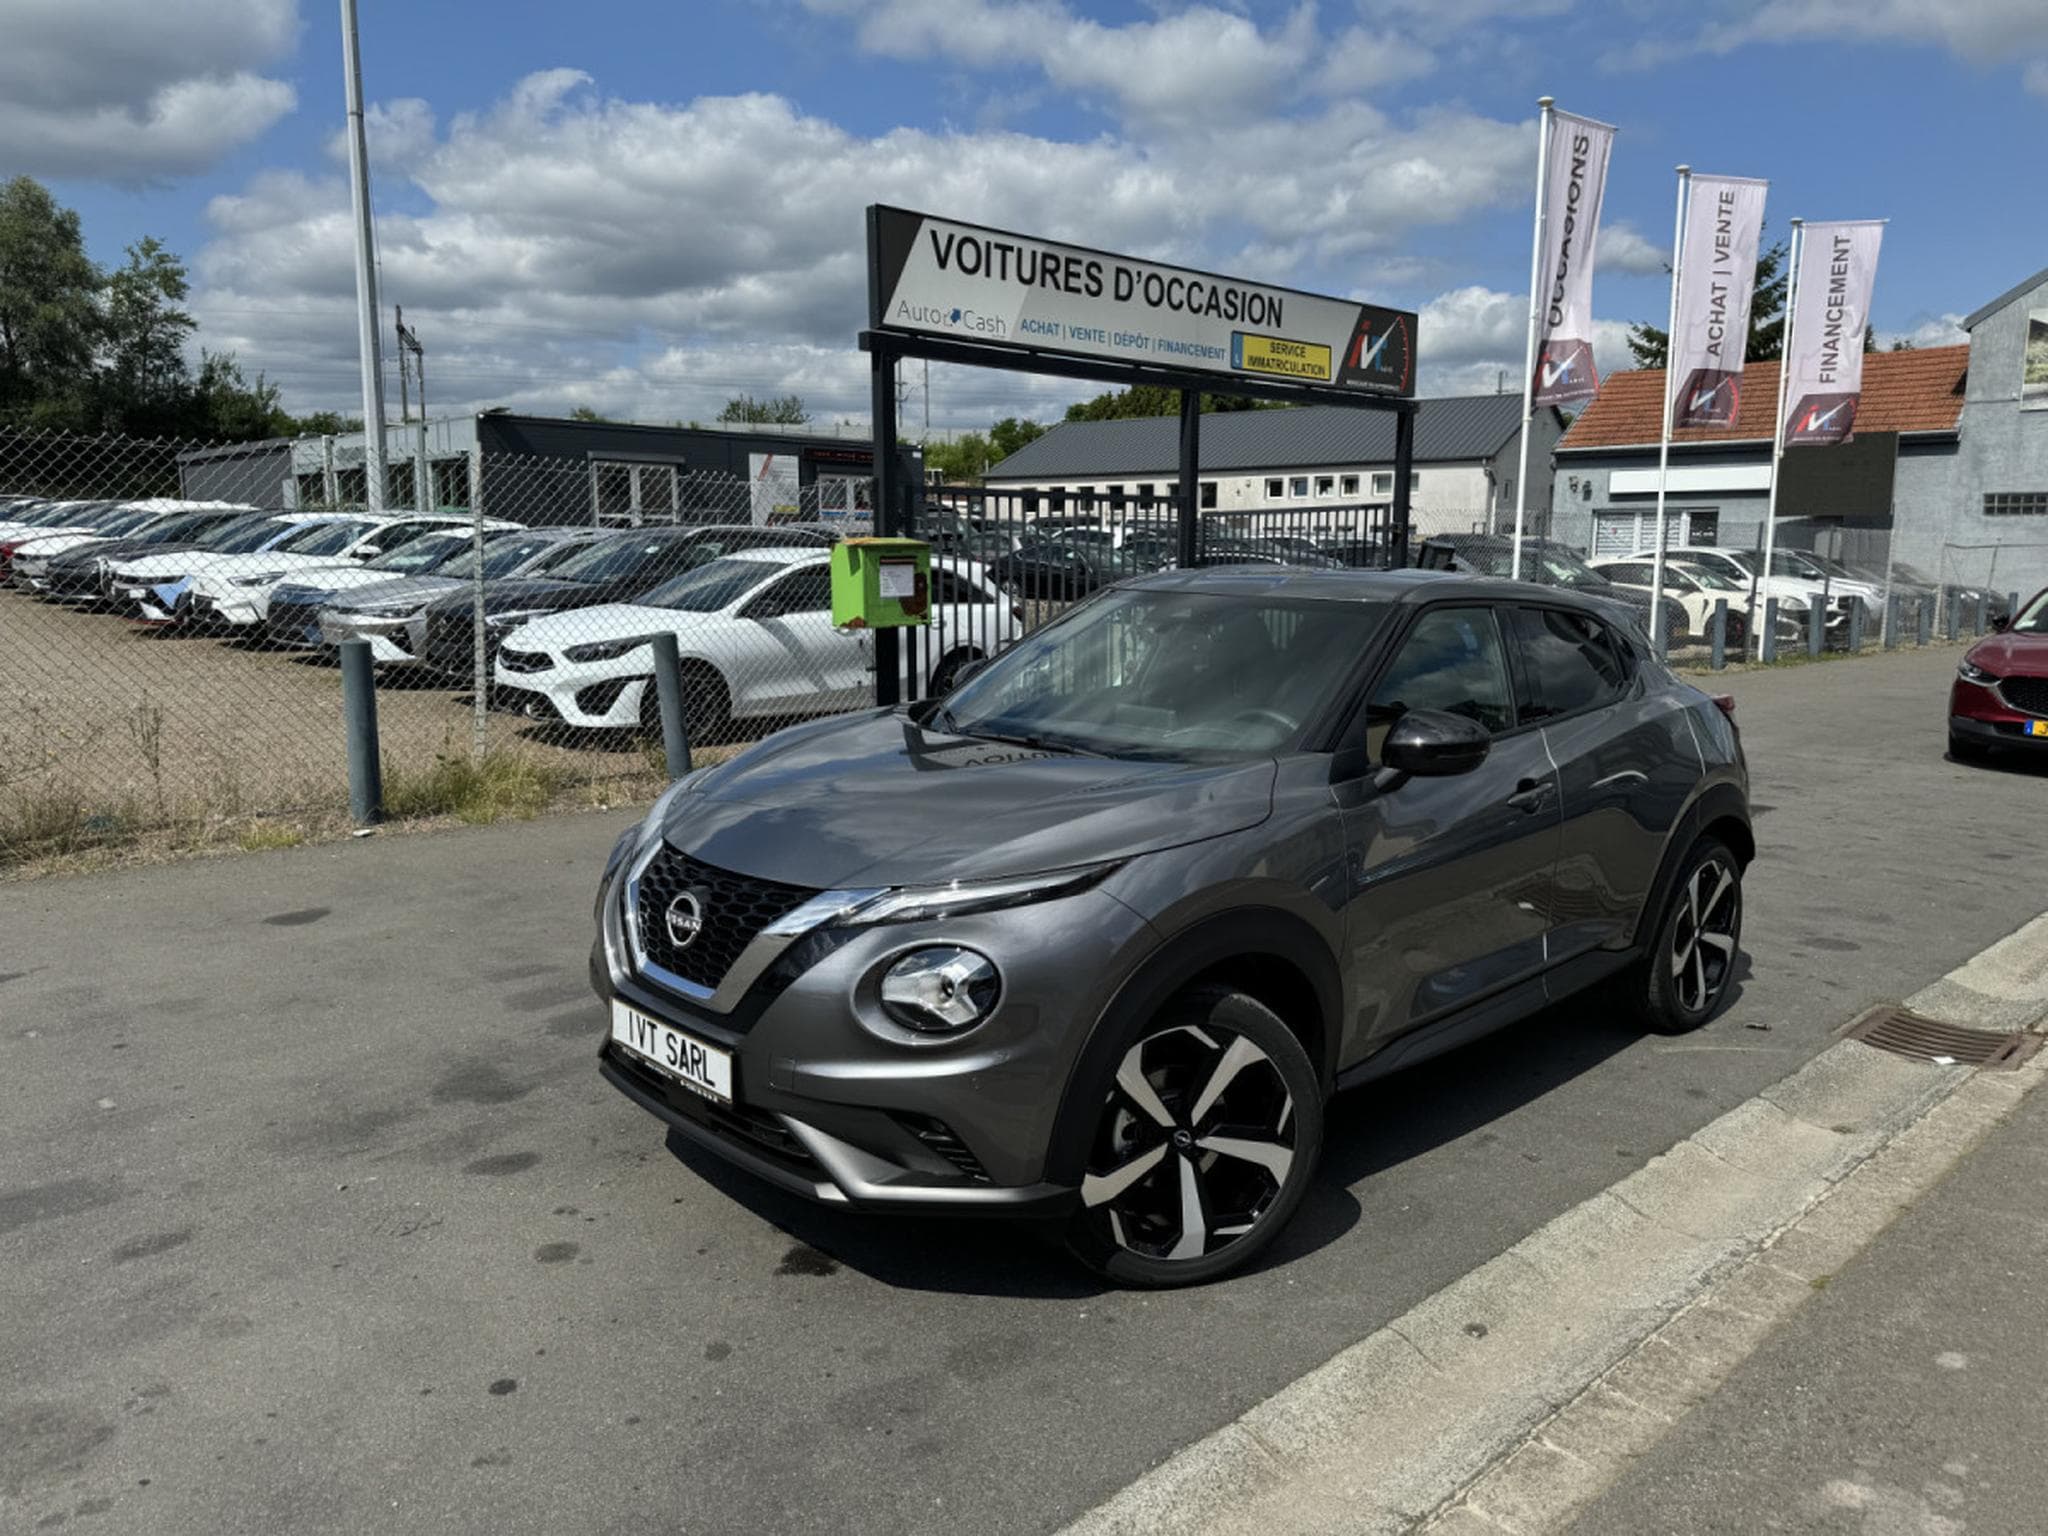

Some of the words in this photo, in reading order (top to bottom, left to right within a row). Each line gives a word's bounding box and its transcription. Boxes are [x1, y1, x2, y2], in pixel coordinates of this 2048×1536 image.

[930, 229, 1103, 298] VOITURES
[1549, 136, 1589, 328] OCCASIONS
[1714, 191, 1735, 267] VENTE
[963, 310, 1006, 334] Cash
[1021, 318, 1060, 336] ACHAT
[1069, 326, 1105, 343] VENTE
[1114, 331, 1150, 349] DÉPÔT
[1158, 339, 1226, 361] FINANCEMENT
[1706, 282, 1728, 356] ACHAT
[1819, 235, 1851, 384] FINANCEMENT
[1247, 355, 1325, 375] IMMATRICULATION
[1270, 341, 1306, 358] SERVICE
[629, 1010, 657, 1054] IVT
[666, 1032, 715, 1088] SARL
